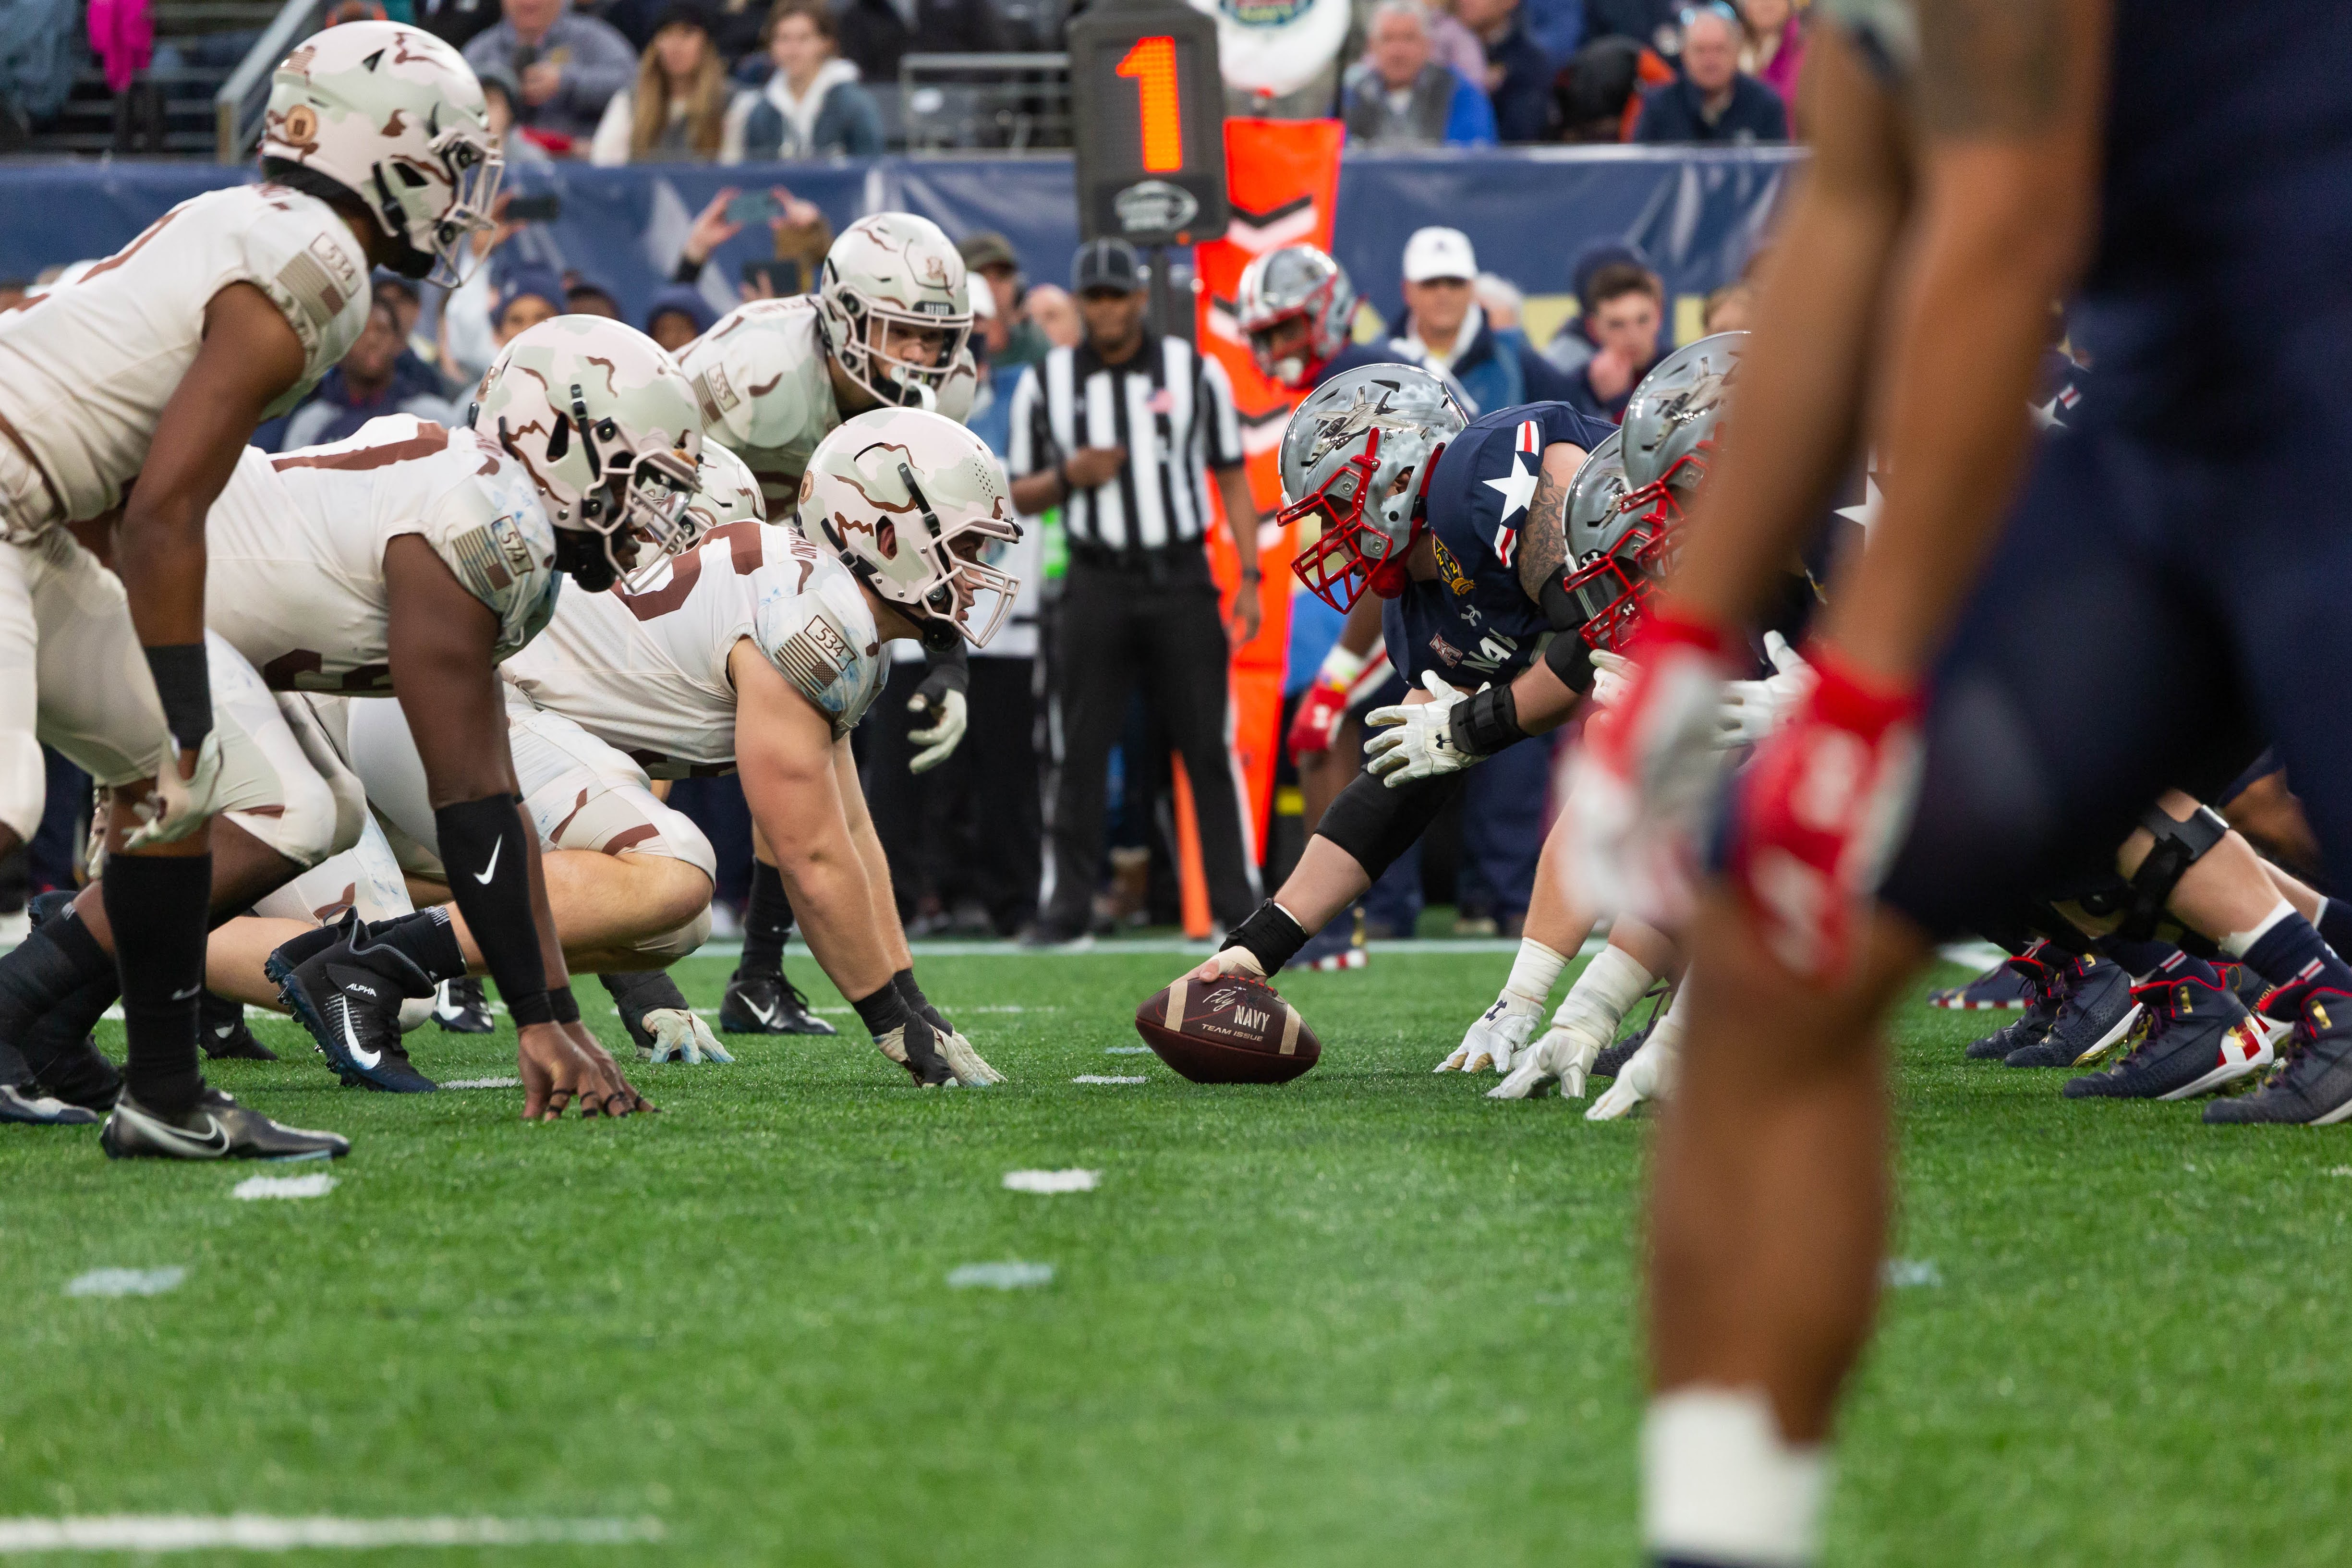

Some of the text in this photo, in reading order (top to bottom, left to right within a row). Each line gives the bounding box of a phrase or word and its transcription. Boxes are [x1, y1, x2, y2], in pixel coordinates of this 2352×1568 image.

[1116, 36, 1182, 172] 1
[500, 532, 526, 562] 574
[815, 627, 846, 657] 534
[1461, 627, 1518, 674] NAV
[346, 983, 376, 997] ALPHA
[1202, 988, 1237, 1012] Fly
[1201, 1023, 1263, 1042] TEAM ISSUE
[1234, 1005, 1271, 1033] NAVY
